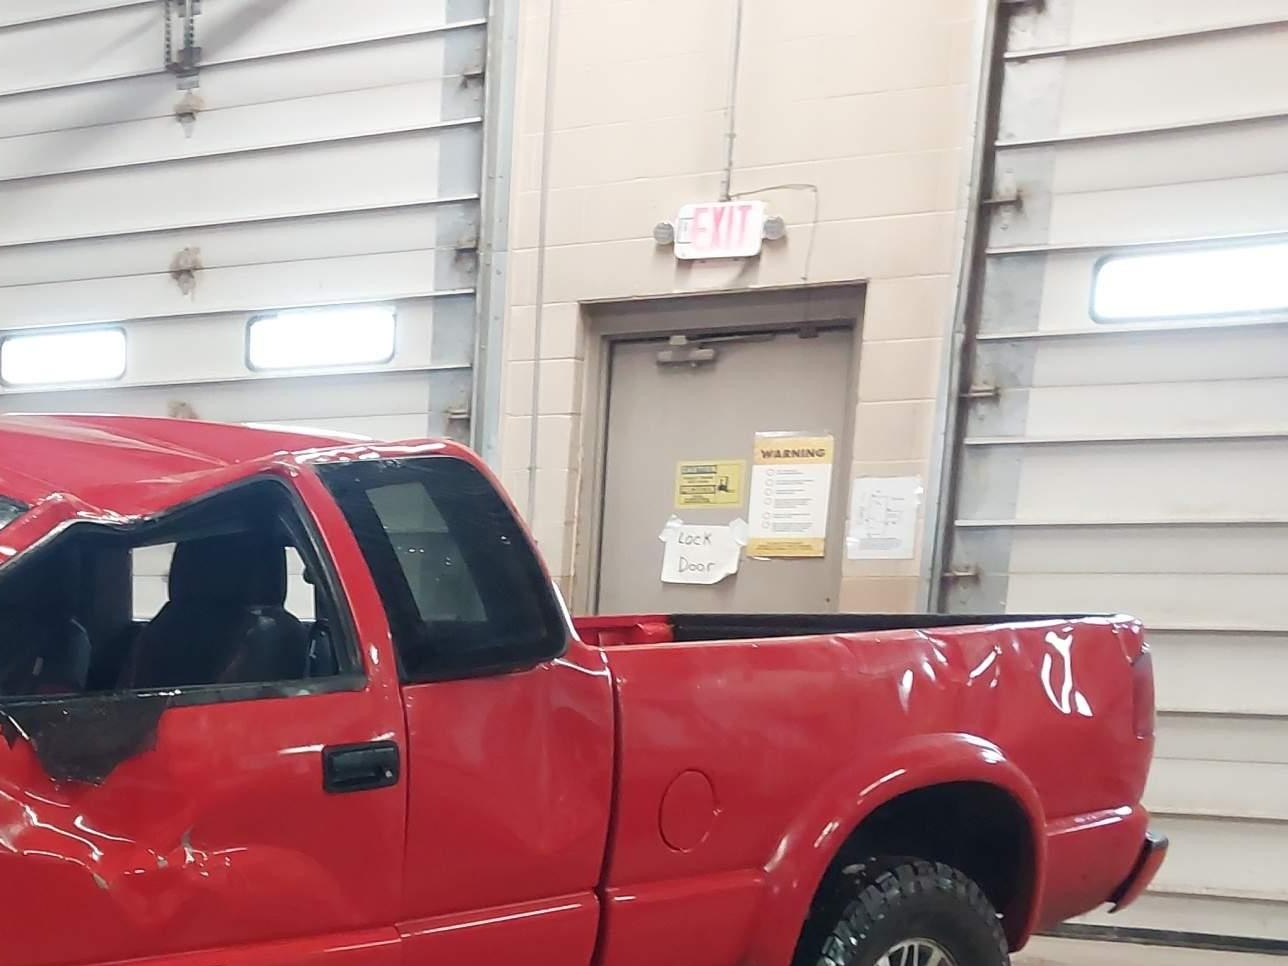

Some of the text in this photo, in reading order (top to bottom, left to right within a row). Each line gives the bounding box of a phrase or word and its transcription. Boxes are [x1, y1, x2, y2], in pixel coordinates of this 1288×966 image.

[691, 204, 754, 249] EXIT
[759, 448, 826, 459] WARNING
[677, 555, 716, 573] Door
